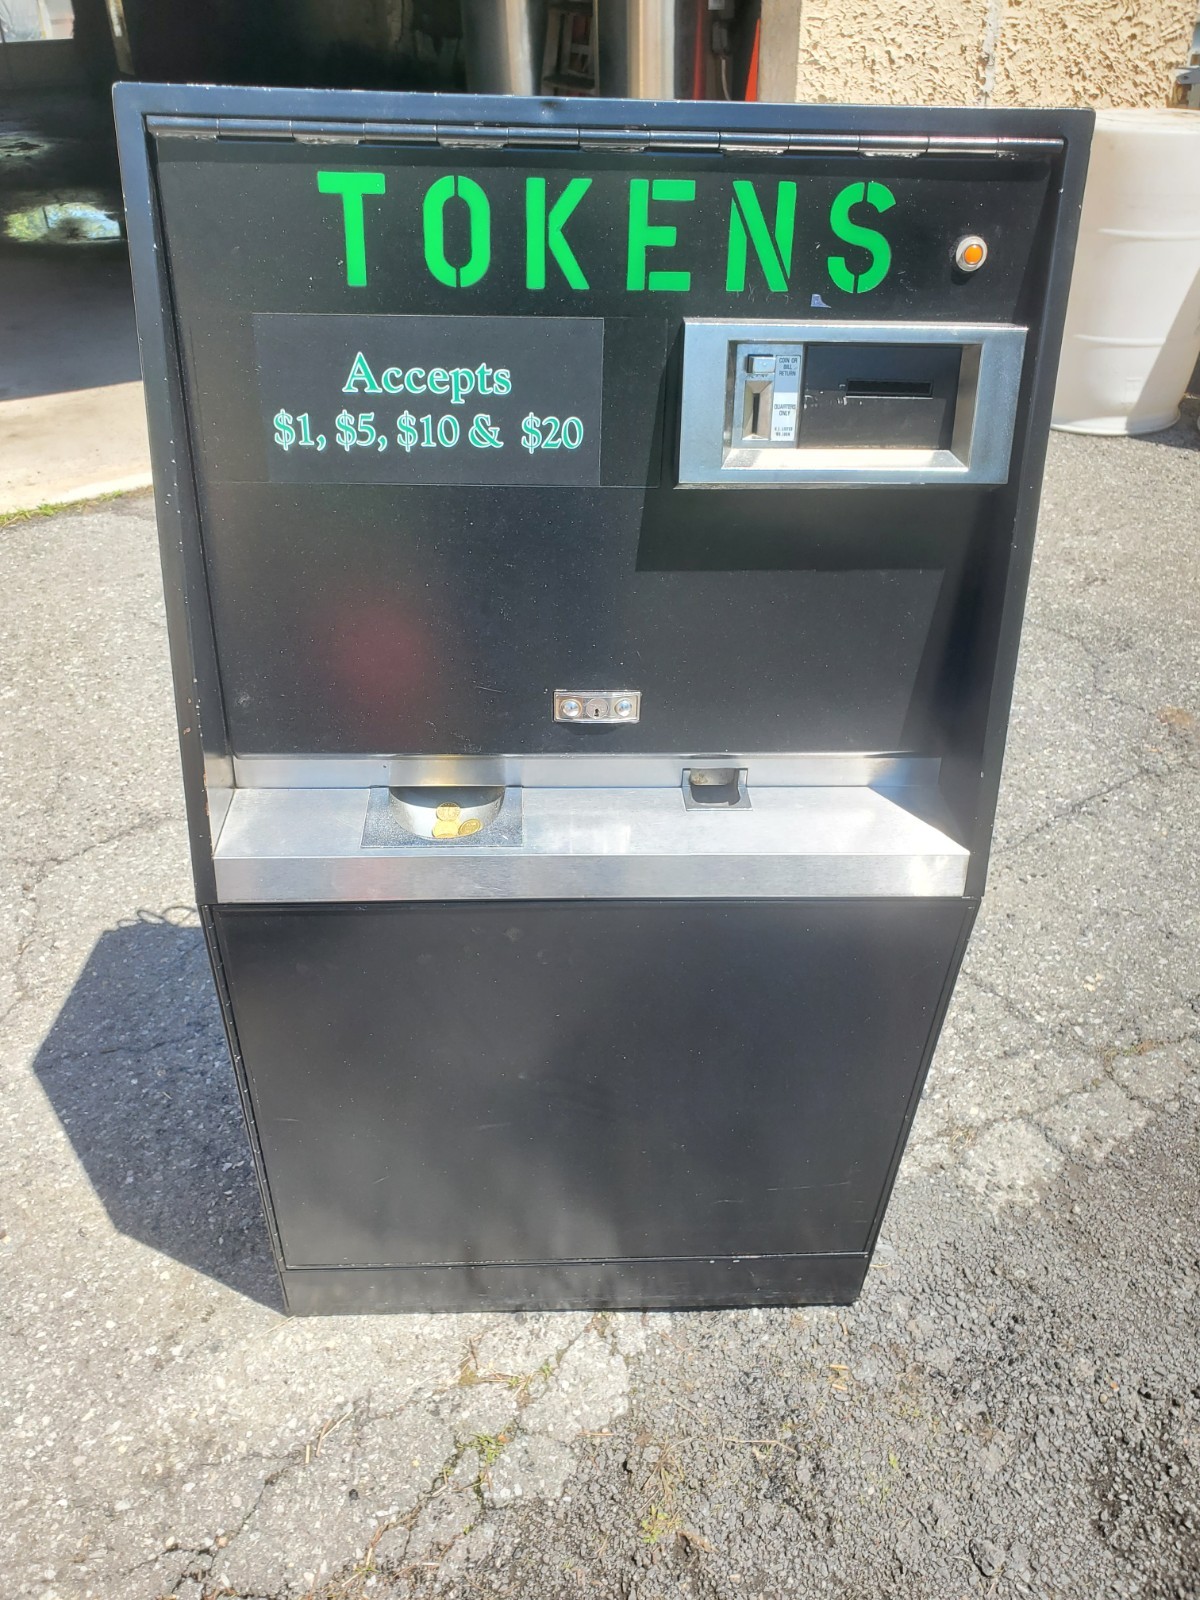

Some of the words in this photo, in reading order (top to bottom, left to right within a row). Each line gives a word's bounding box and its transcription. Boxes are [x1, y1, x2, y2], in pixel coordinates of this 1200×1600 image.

[316, 170, 897, 293] TOKENS
[341, 351, 512, 405] Accepts
[272, 407, 327, 452] $1,
[334, 407, 388, 453] $5,
[396, 409, 461, 453] $10
[467, 412, 505, 449] &
[520, 411, 584, 455] $20
